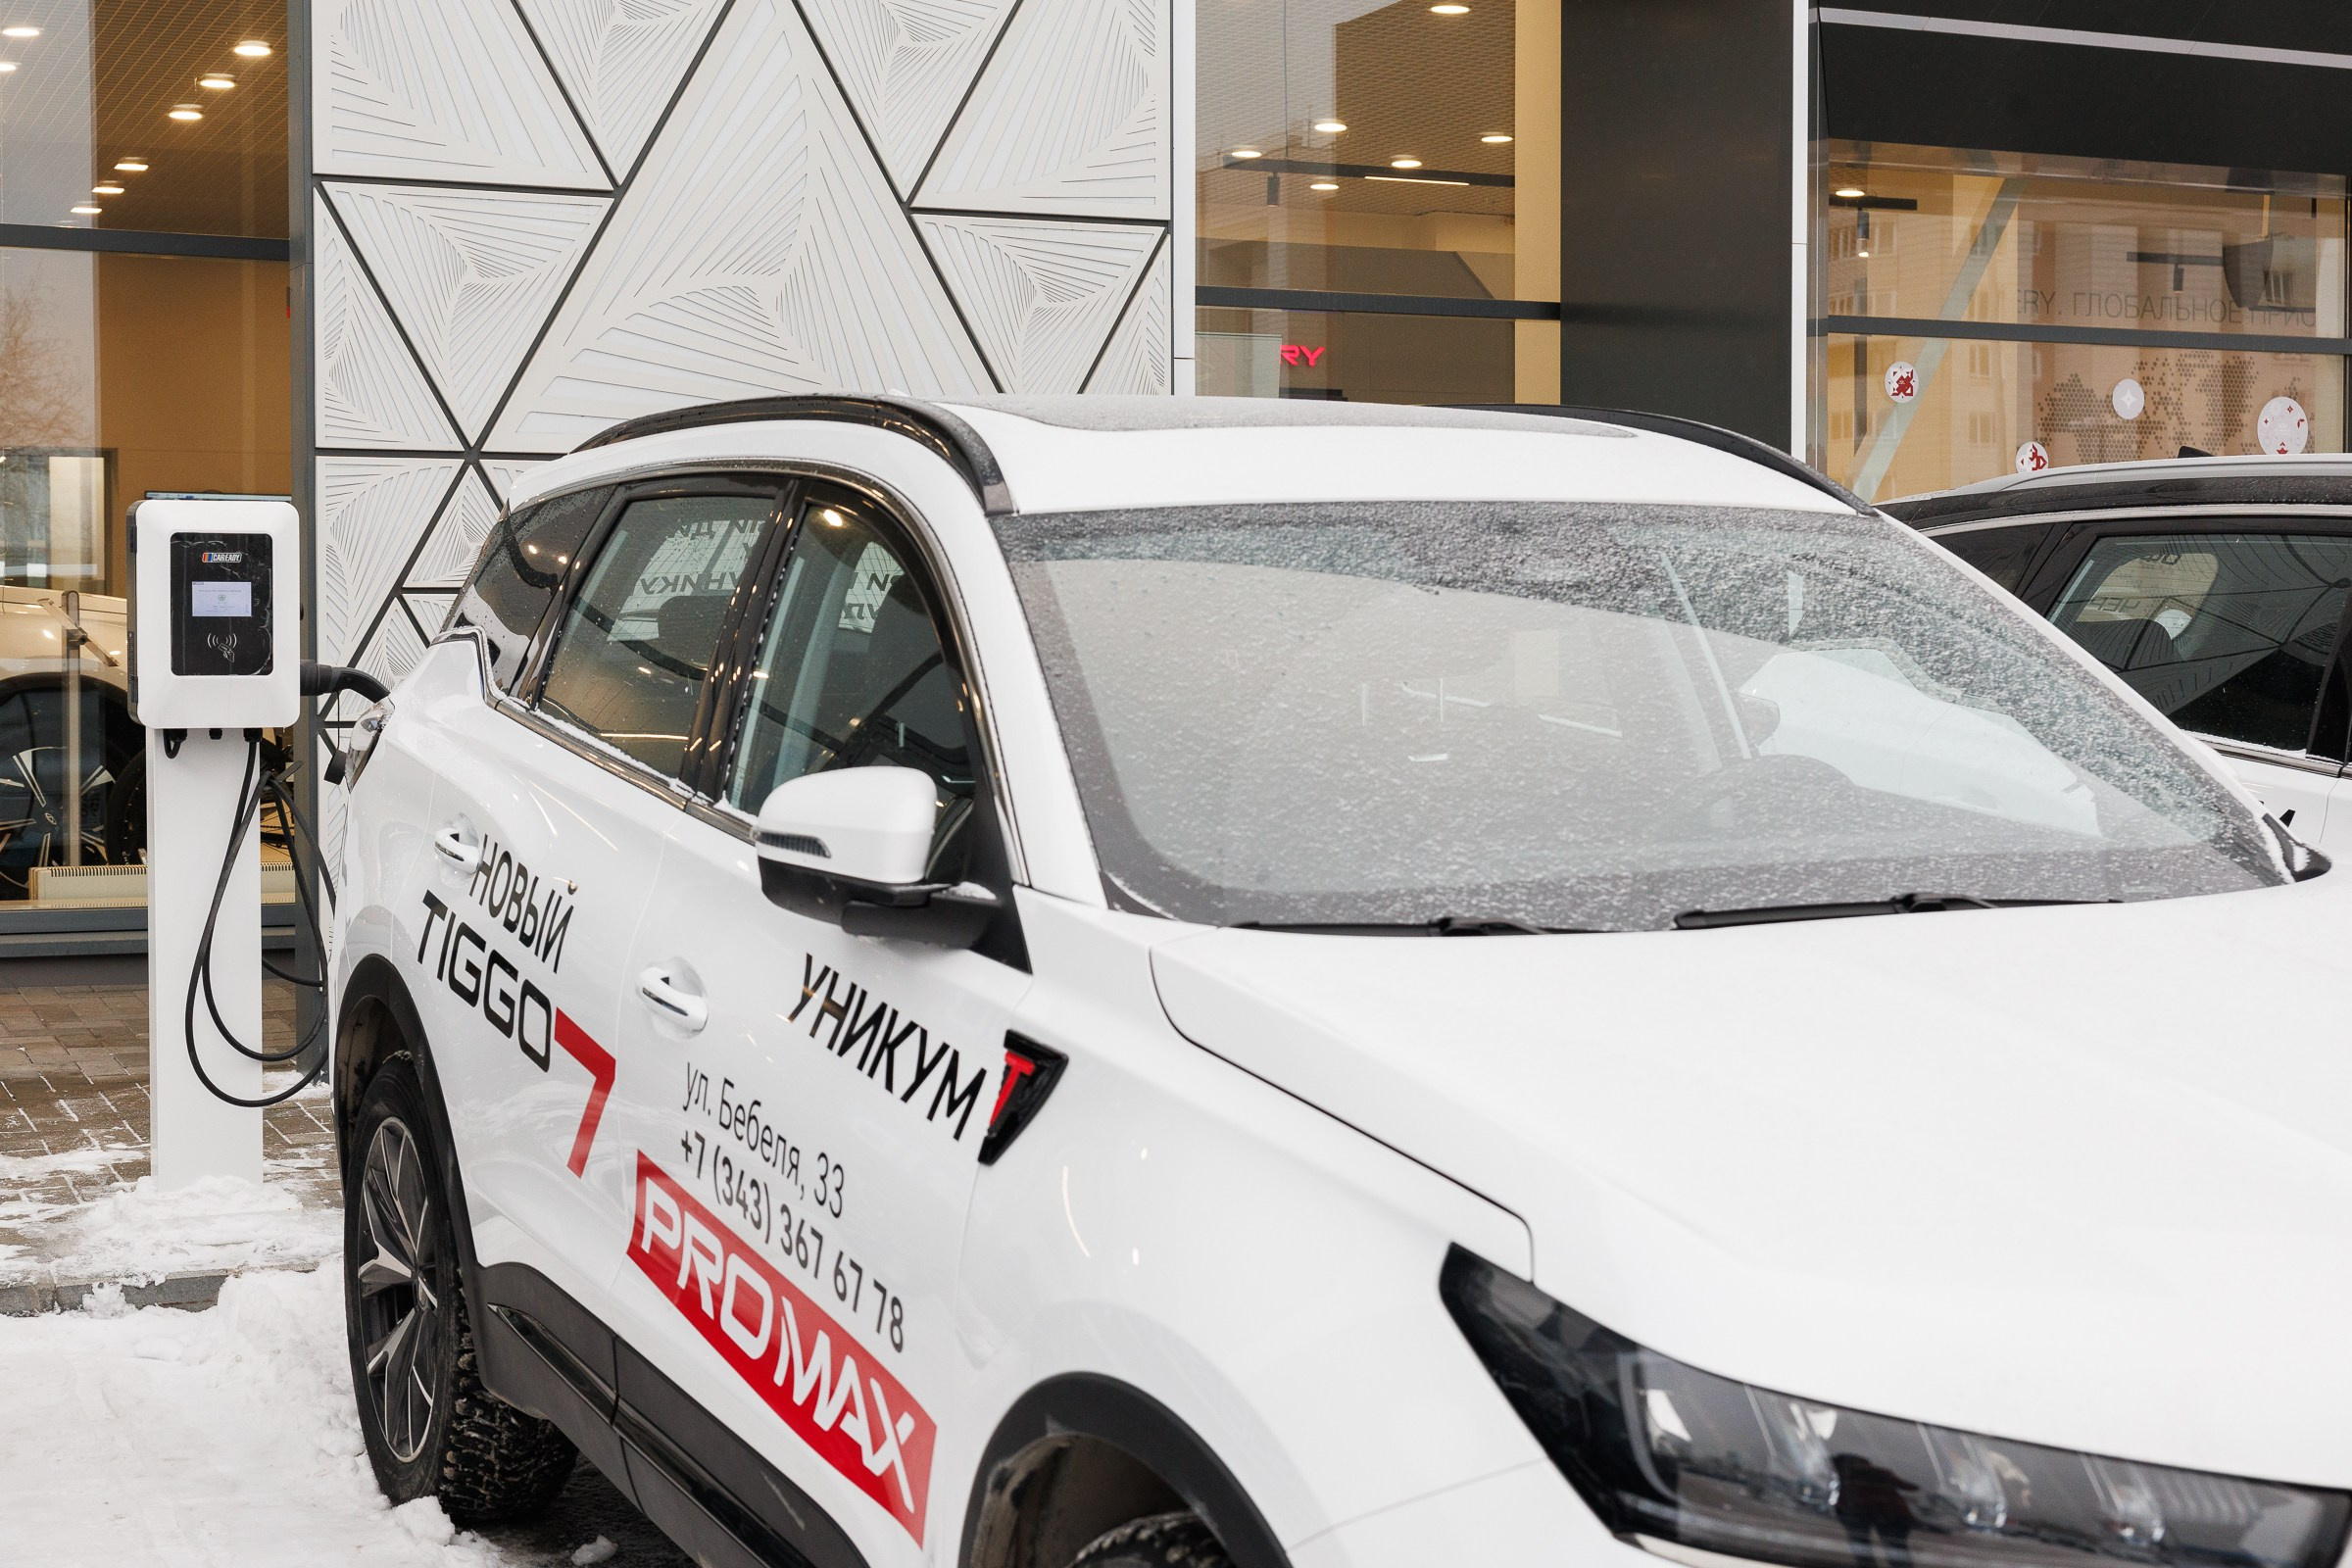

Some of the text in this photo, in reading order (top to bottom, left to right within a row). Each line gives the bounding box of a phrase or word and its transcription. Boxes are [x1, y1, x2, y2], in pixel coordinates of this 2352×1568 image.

[2074, 292, 2242, 324] ГЛОБАЛЬНОЕ
[213, 553, 240, 563] CAREADY
[469, 833, 578, 974] НОВЫЙ
[417, 889, 616, 1178] TIGGO 7
[788, 953, 987, 1141] УНИКУМ
[683, 1062, 845, 1218] ул. Бебеля, 33
[681, 1130, 905, 1353] +7 (343) 367 67 78
